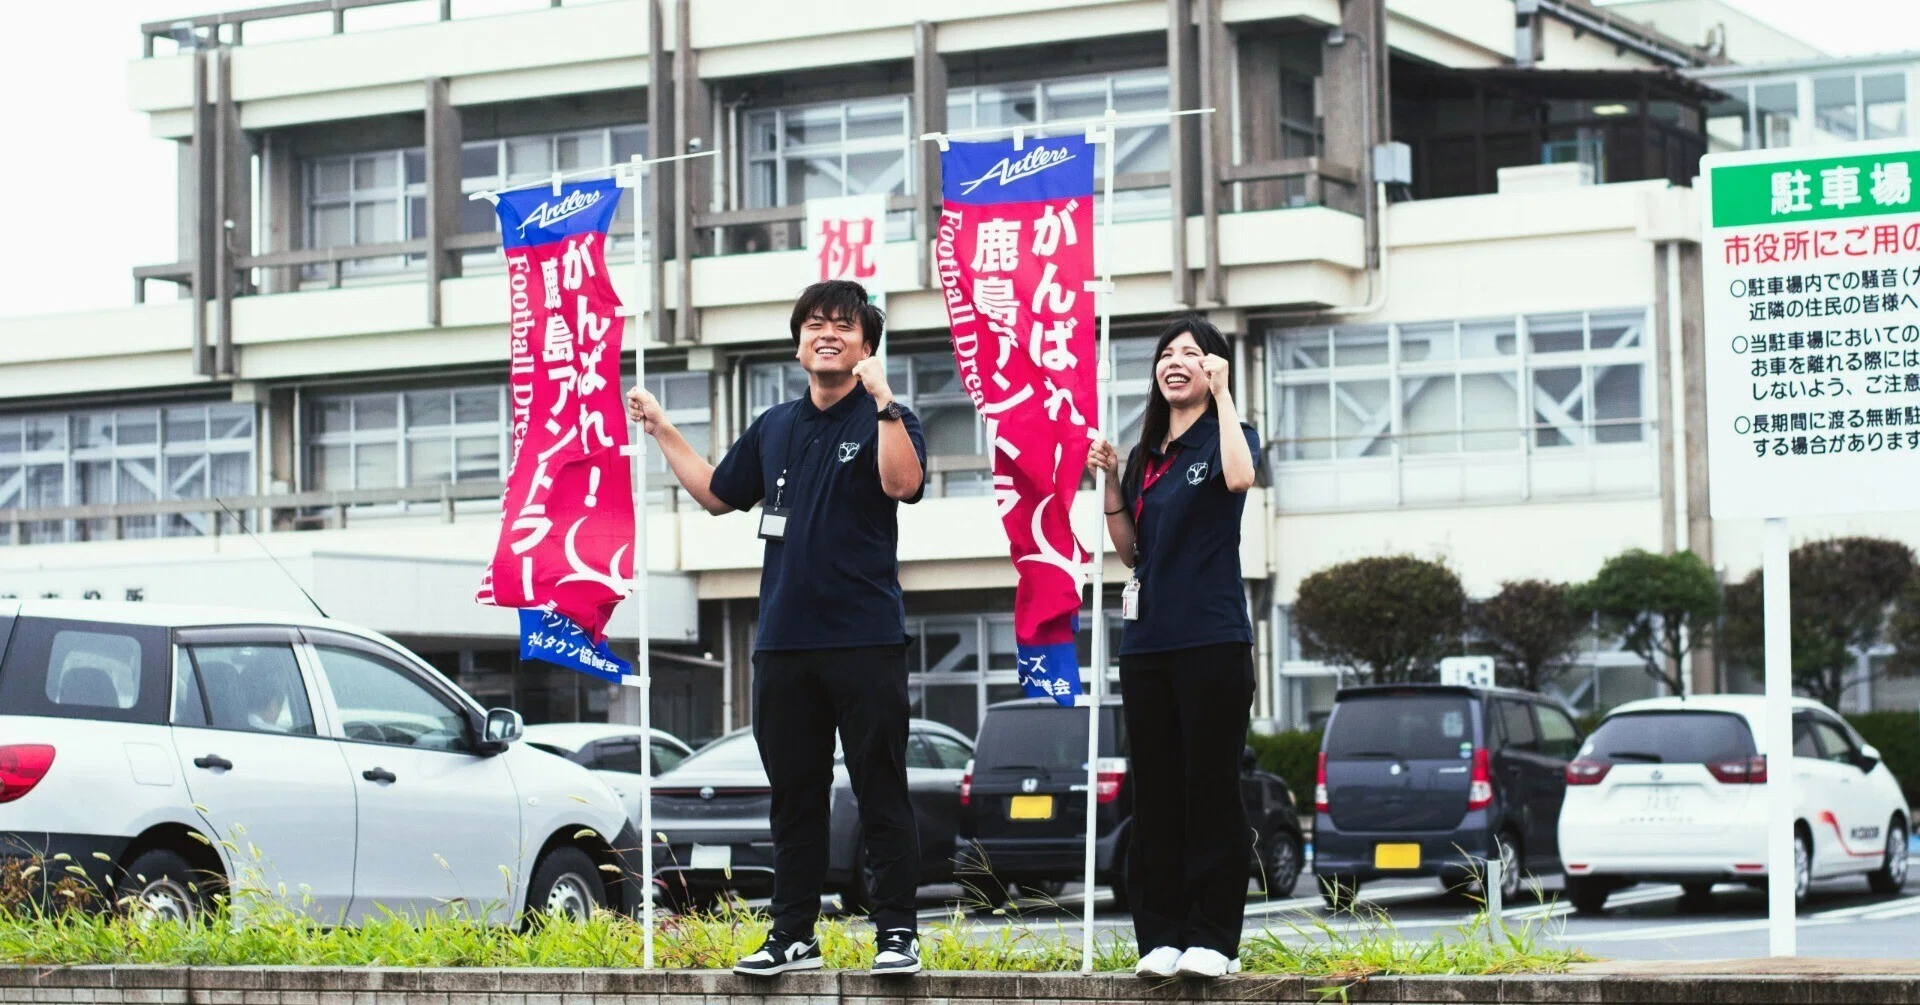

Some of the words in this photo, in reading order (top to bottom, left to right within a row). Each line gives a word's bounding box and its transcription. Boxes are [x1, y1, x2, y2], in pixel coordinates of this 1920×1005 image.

[960, 145, 1076, 196] Antlers
[1770, 161, 1912, 216] 駐車場
[516, 189, 604, 239] Antlers
[816, 217, 876, 282] 祝
[938, 208, 976, 327] Football
[508, 253, 535, 376] Football
[1749, 292, 1919, 322] 近隣の住民の皆様へ
[1751, 349, 1920, 378] お車を離れる際には
[1752, 372, 1920, 401] しないよう、ご注意
[1753, 430, 1920, 458] する場合があります
